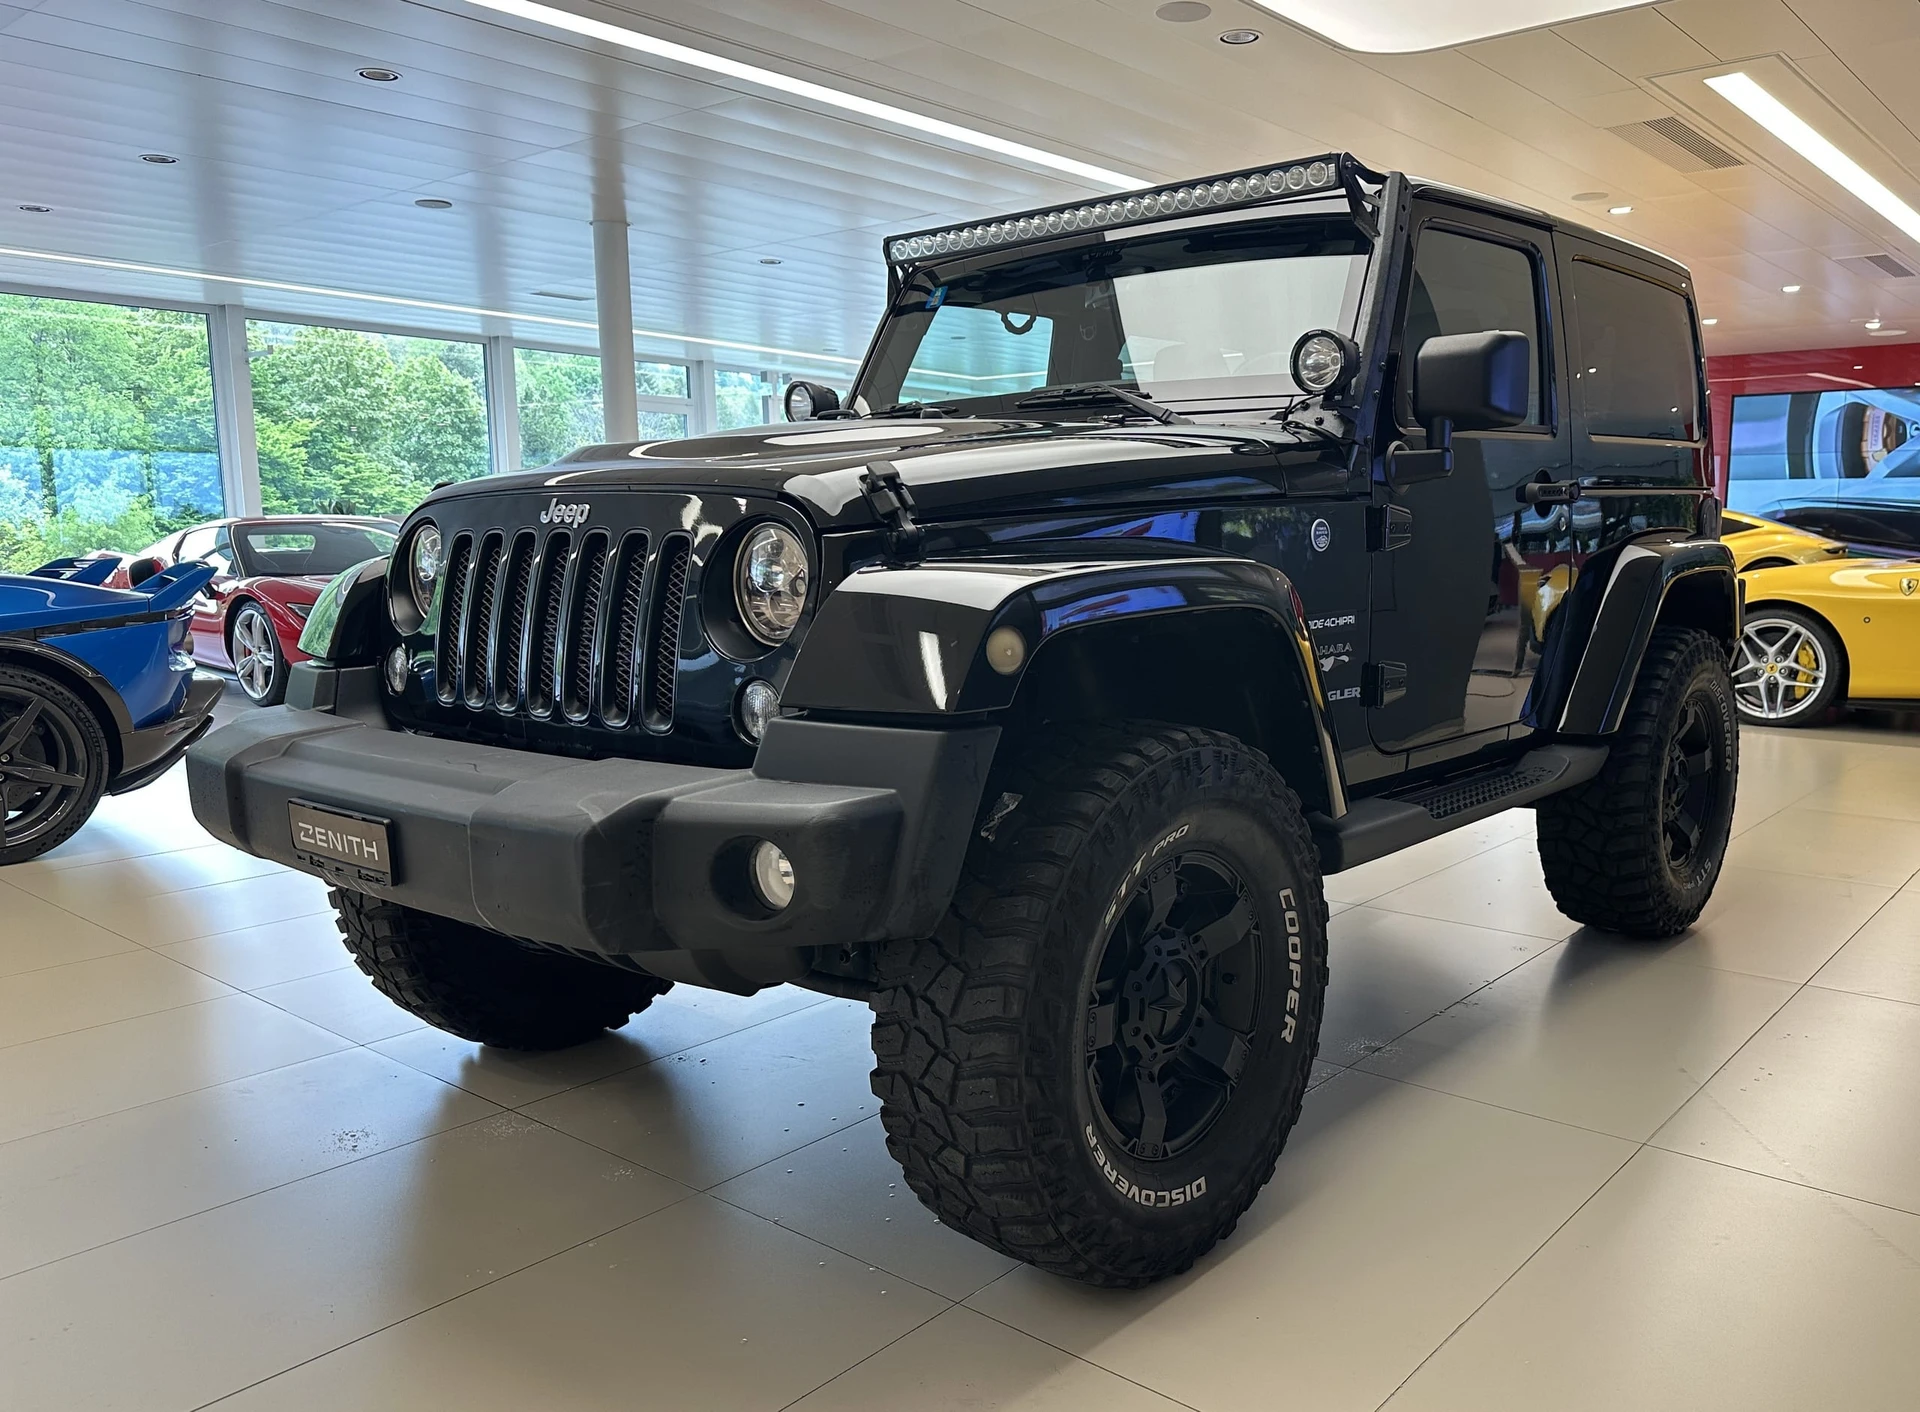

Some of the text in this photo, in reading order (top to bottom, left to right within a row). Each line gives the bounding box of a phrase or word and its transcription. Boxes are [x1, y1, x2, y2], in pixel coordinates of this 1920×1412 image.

[540, 498, 590, 528] Jeep
[1319, 642, 1353, 656] HARA
[1327, 686, 1361, 701] GLER
[1709, 680, 1732, 772] DISCOVERER
[298, 822, 379, 861] ZENITH
[1152, 824, 1190, 857] PRO
[1279, 887, 1302, 1044] COOPER
[1085, 1121, 1207, 1208] DISCOVERER
